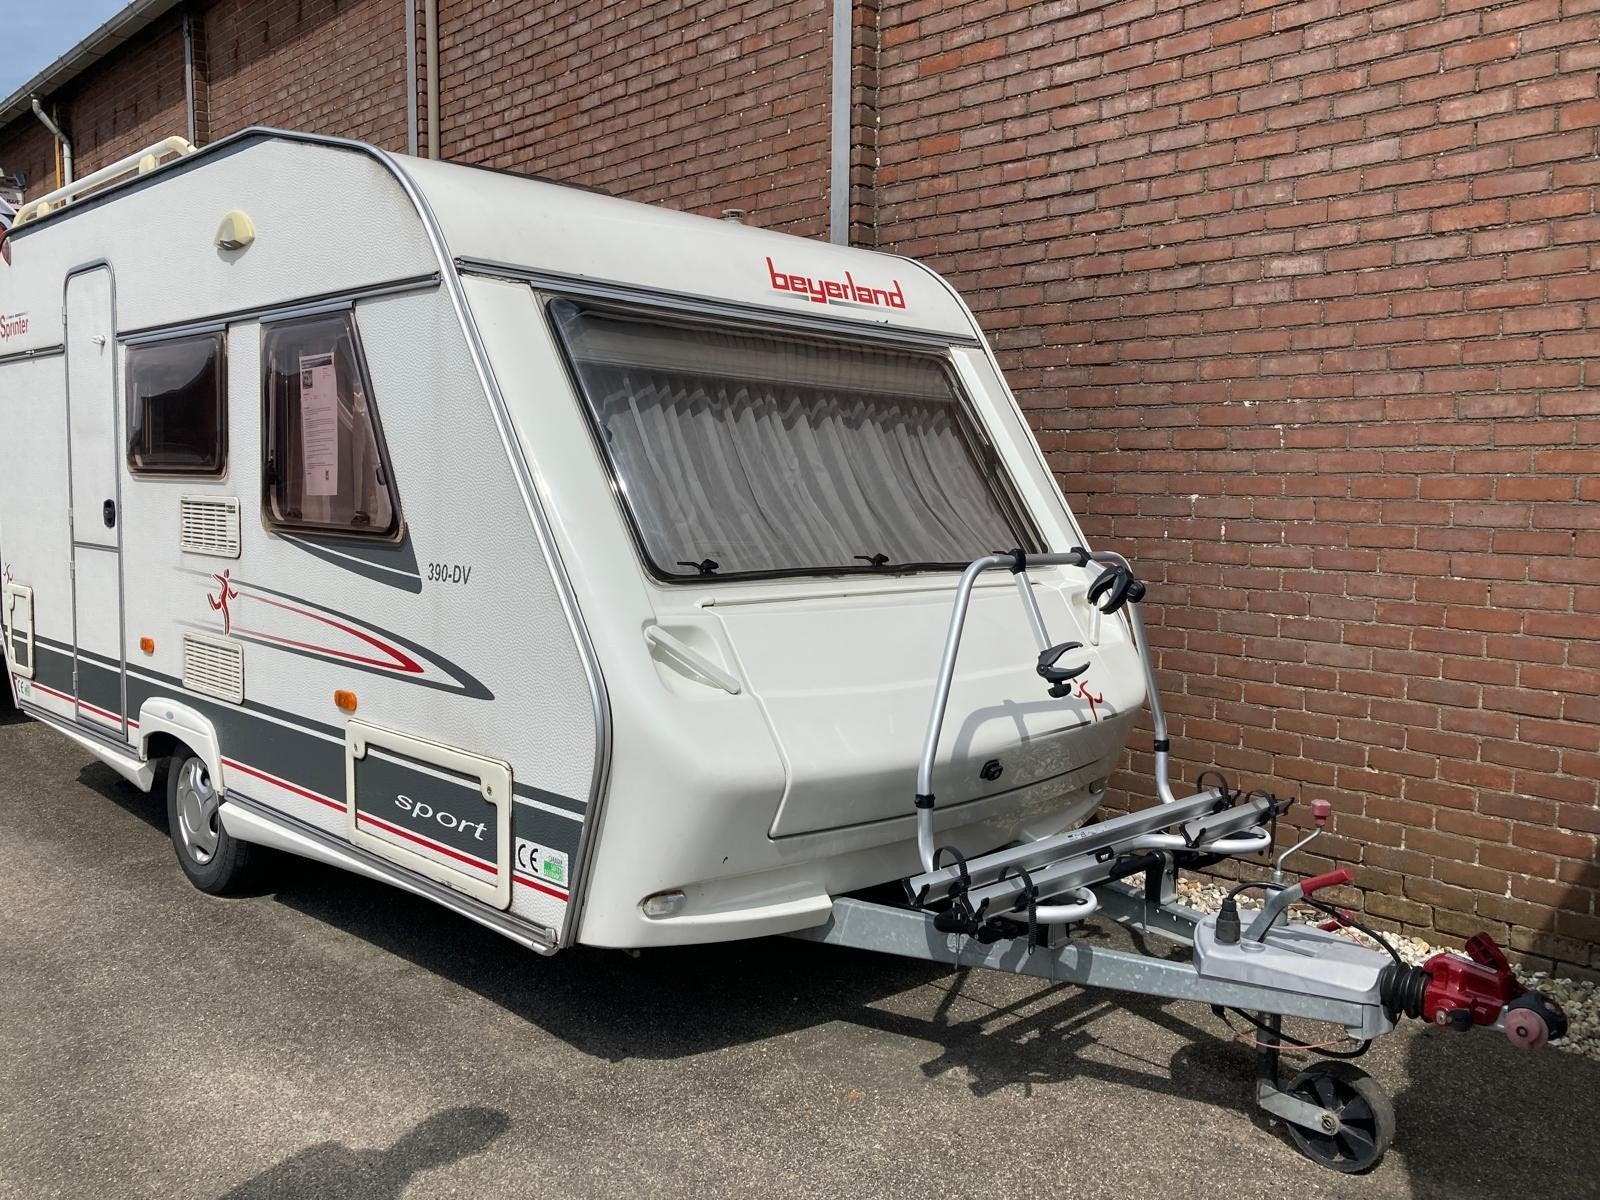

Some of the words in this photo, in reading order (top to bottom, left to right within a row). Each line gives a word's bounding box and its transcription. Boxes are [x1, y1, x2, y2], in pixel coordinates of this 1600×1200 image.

[766, 256, 905, 309] beyerland
[0, 315, 29, 342] Sprinter
[427, 562, 472, 585] 390-DV
[394, 794, 488, 841] sport
[517, 843, 539, 873] CE
